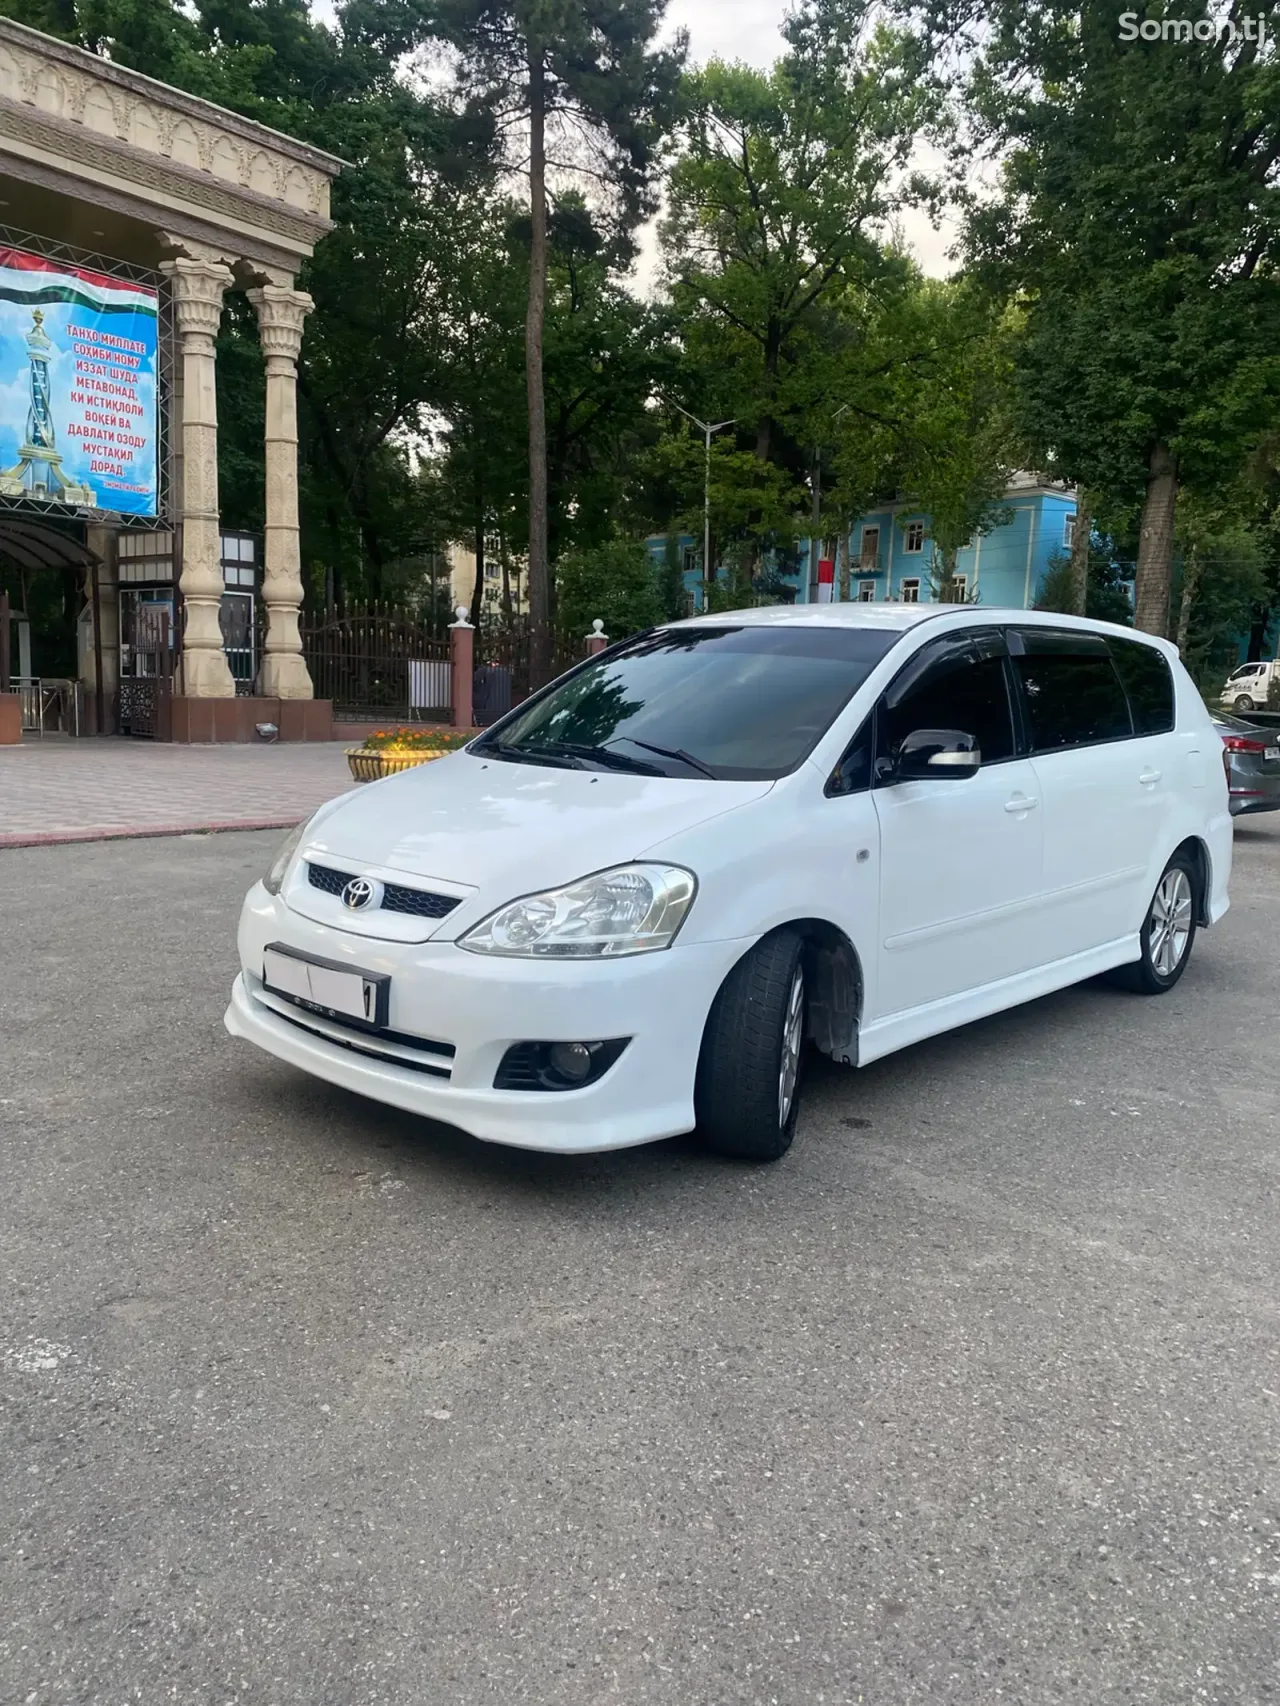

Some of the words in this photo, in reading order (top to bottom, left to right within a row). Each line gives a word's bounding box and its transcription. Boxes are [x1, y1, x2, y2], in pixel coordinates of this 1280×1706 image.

[101, 333, 146, 354] МИЛЛАТЕ
[114, 352, 141, 368] НОМУ
[76, 360, 108, 376] ИЗЗАТ
[110, 368, 139, 384] ШУДА
[70, 391, 84, 404] КИ
[118, 417, 131, 430] ВА
[67, 423, 115, 442] ДАВЛАТИ
[116, 432, 147, 449] ОЗОДУ
